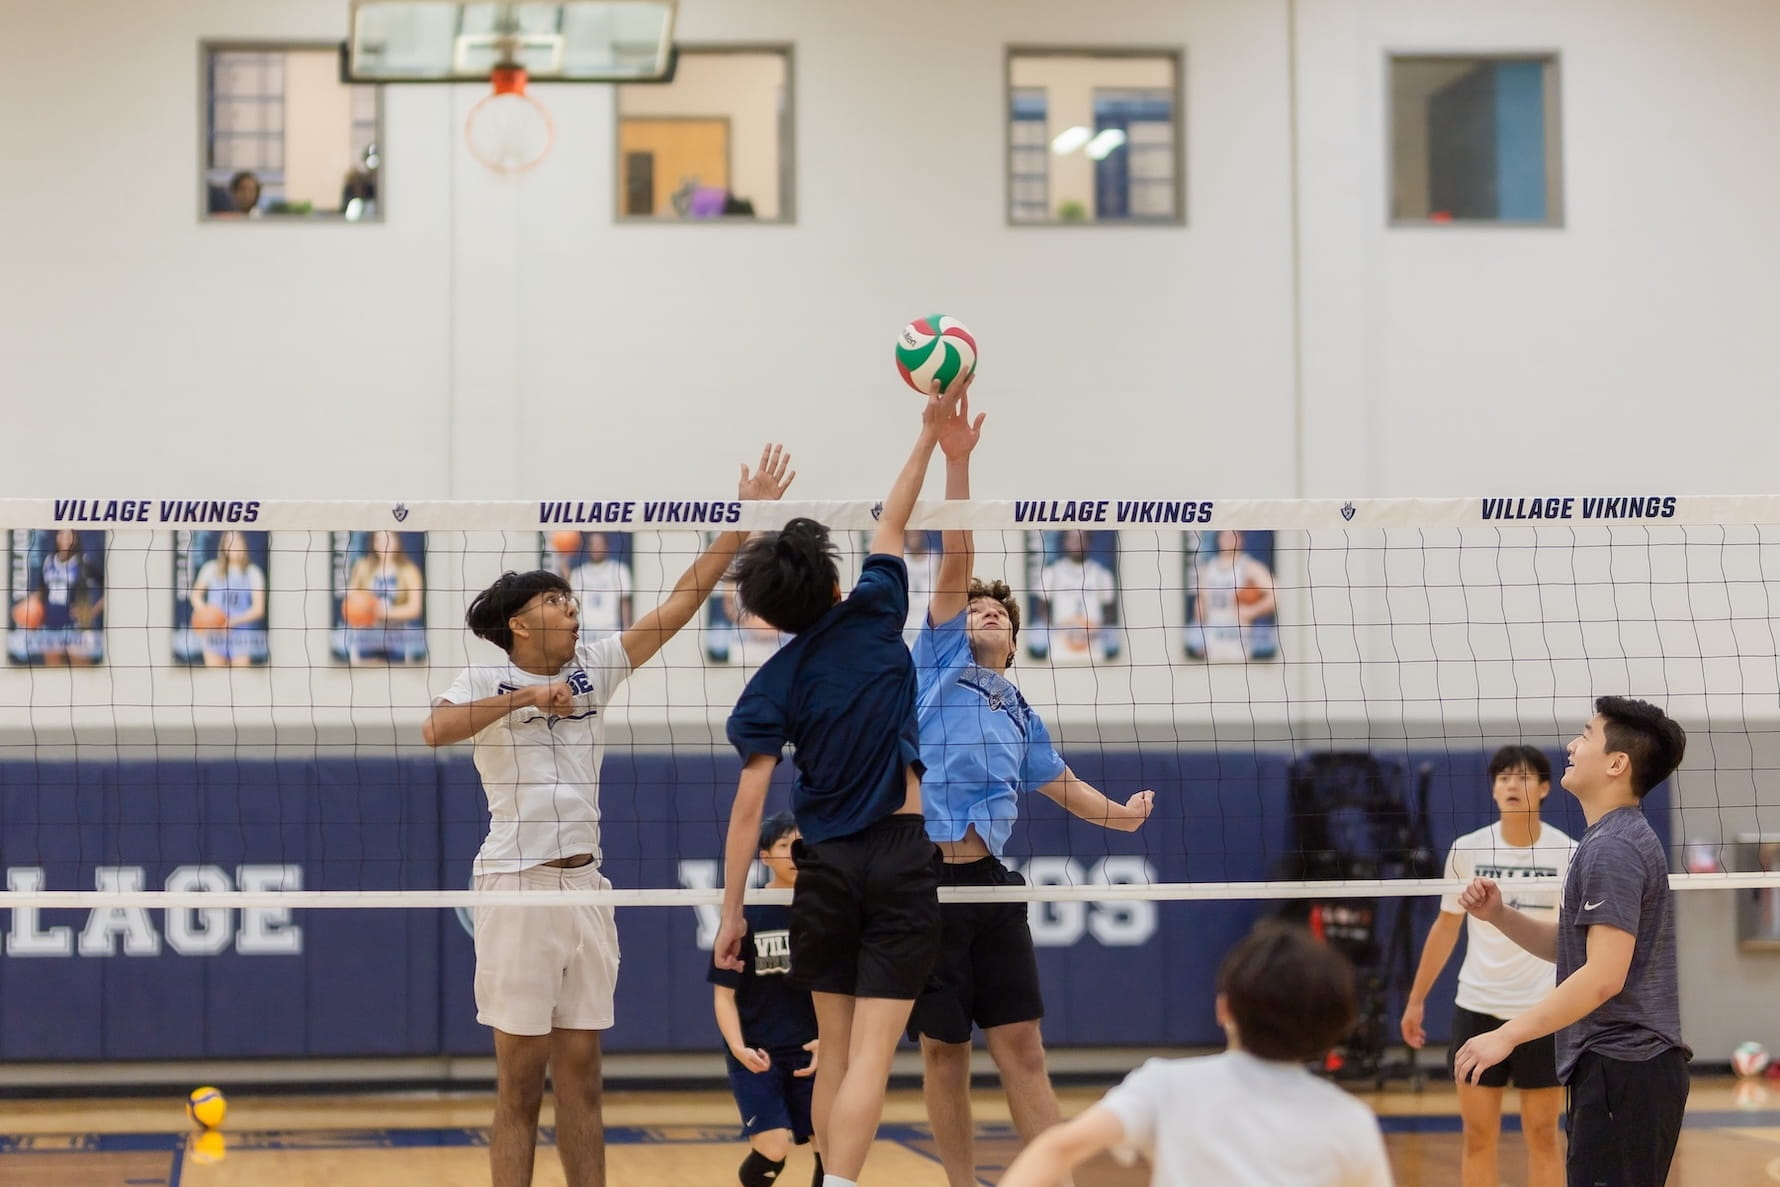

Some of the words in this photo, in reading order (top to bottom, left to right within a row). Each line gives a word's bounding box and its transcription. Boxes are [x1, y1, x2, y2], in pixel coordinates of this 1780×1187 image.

[54, 500, 152, 521] VILLAGE
[159, 501, 261, 523] VIKINGS
[539, 502, 635, 523] VILLAGE
[643, 502, 742, 523] VIKINGS
[1014, 501, 1109, 522] VILLAGE
[1116, 502, 1214, 523] VIKINGS
[1482, 498, 1575, 519] VILLAGE
[1582, 497, 1677, 518] VIKINGS
[0, 864, 304, 958] LAGE
